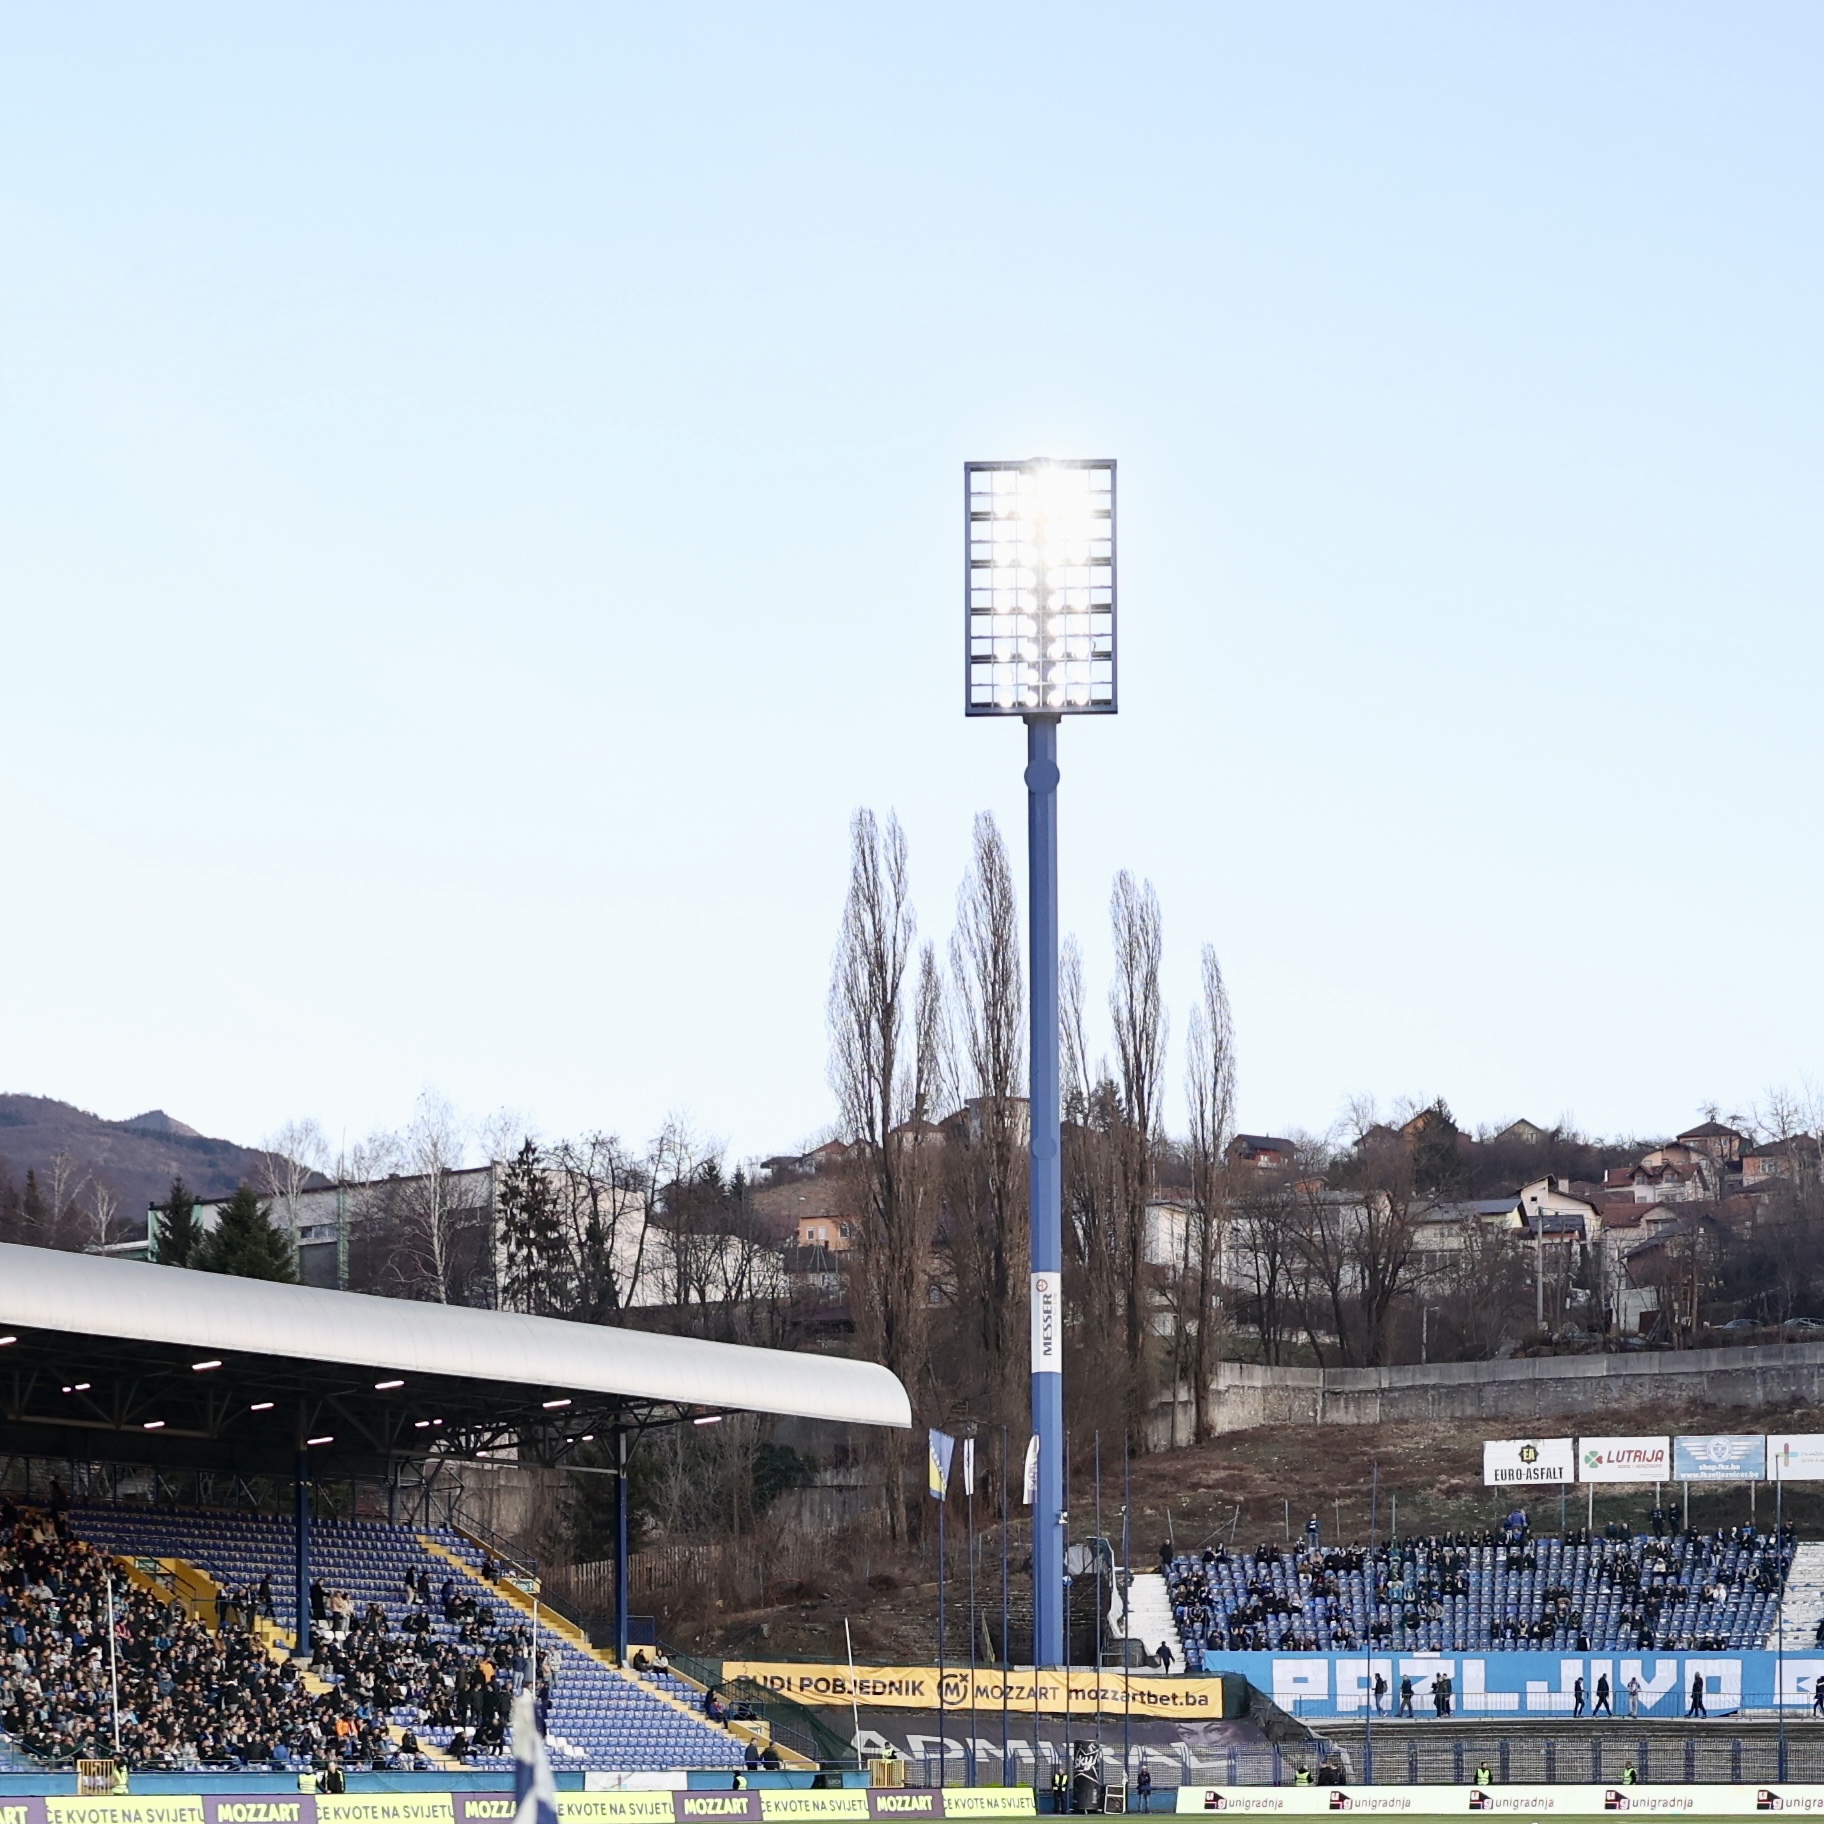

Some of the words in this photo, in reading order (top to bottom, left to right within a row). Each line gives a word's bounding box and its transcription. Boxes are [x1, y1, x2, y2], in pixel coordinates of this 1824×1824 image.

[1043, 1293, 1052, 1356] MESSER
[1606, 1450, 1665, 1463] LUTRIJA
[1494, 1467, 1564, 1481] EURO-ASFALT
[799, 1676, 925, 1697] POBJEDNIK
[975, 1685, 1060, 1700] MOZZART
[1068, 1687, 1210, 1708] mozzartbet.ba
[465, 1800, 517, 1819] MOZZA
[567, 1803, 606, 1817] KVOTE
[610, 1802, 626, 1816] NA
[684, 1797, 748, 1815] MOZZART
[773, 1801, 812, 1813] KVOTE
[814, 1800, 828, 1812] NA
[877, 1795, 933, 1812] MOZZART
[954, 1799, 983, 1812] KVOTE
[986, 1798, 999, 1810] NA
[1229, 1797, 1284, 1811] unigradnja
[1355, 1797, 1411, 1811] unigradnja
[1495, 1797, 1555, 1811] unigradnja
[1632, 1797, 1694, 1811] unigradnja
[66, 1809, 119, 1824] KVOTE
[122, 1808, 144, 1823] NA
[217, 1803, 300, 1823] MOZZART
[333, 1806, 379, 1820] KVOTE
[382, 1805, 399, 1819] NA
